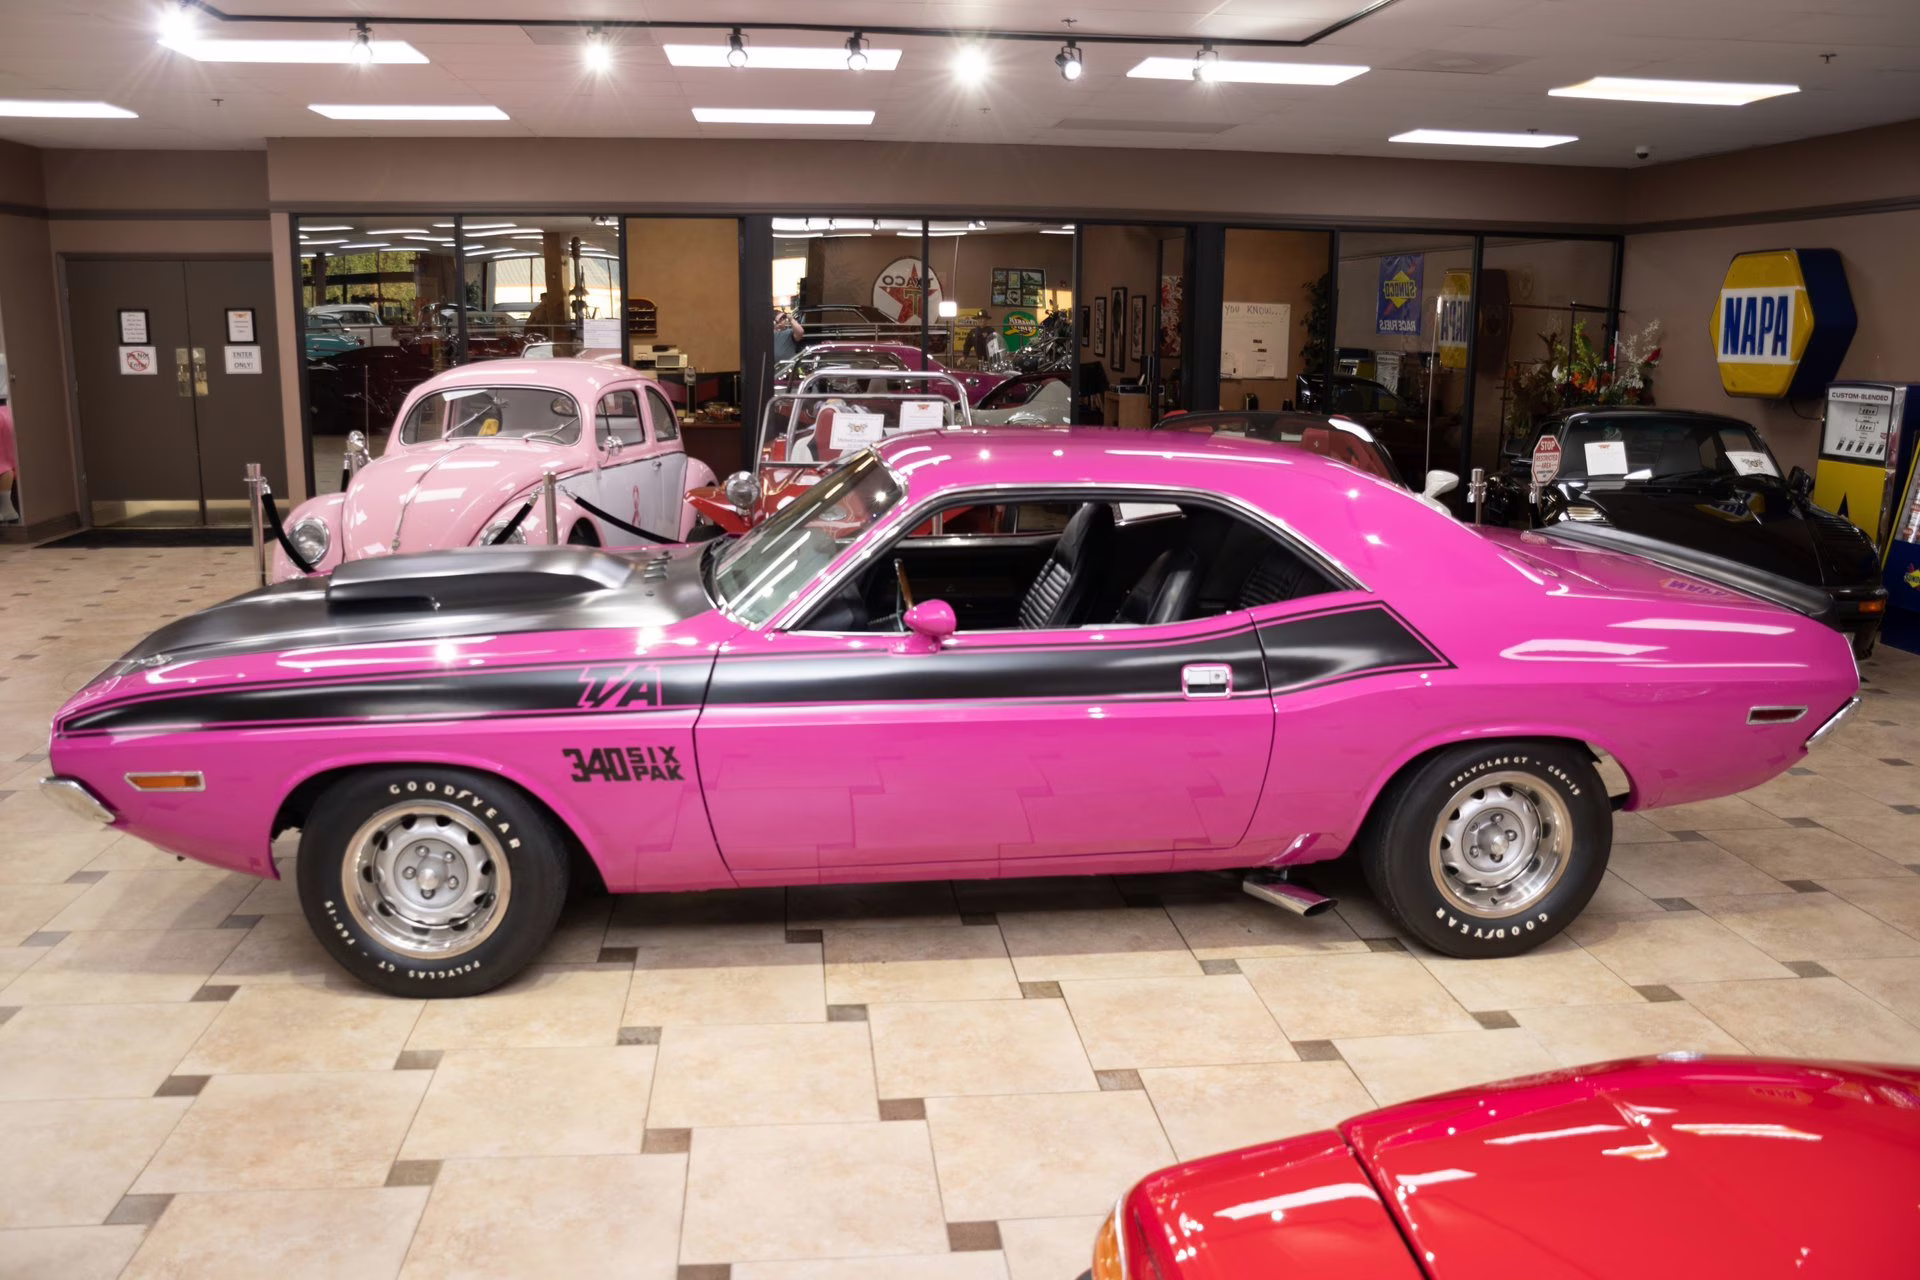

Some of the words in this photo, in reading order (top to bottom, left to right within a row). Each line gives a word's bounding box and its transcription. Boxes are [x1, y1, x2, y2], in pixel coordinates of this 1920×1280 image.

[1224, 304, 1240, 316] YOU
[1722, 295, 1789, 356] NAPA
[232, 351, 253, 359] ENTER
[1831, 391, 1889, 402] CUSTOM-BLENDED
[1540, 440, 1555, 451] STOP
[626, 746, 680, 764] SIX
[562, 747, 632, 782] 340
[631, 764, 685, 782] PAK
[1450, 756, 1509, 788] POLYGLAS
[1513, 756, 1528, 764] GT
[389, 780, 521, 849] GOODYEAR
[1436, 907, 1549, 940] GOODYEAR
[378, 959, 396, 973] GT
[408, 959, 481, 980] POLYGLAS
